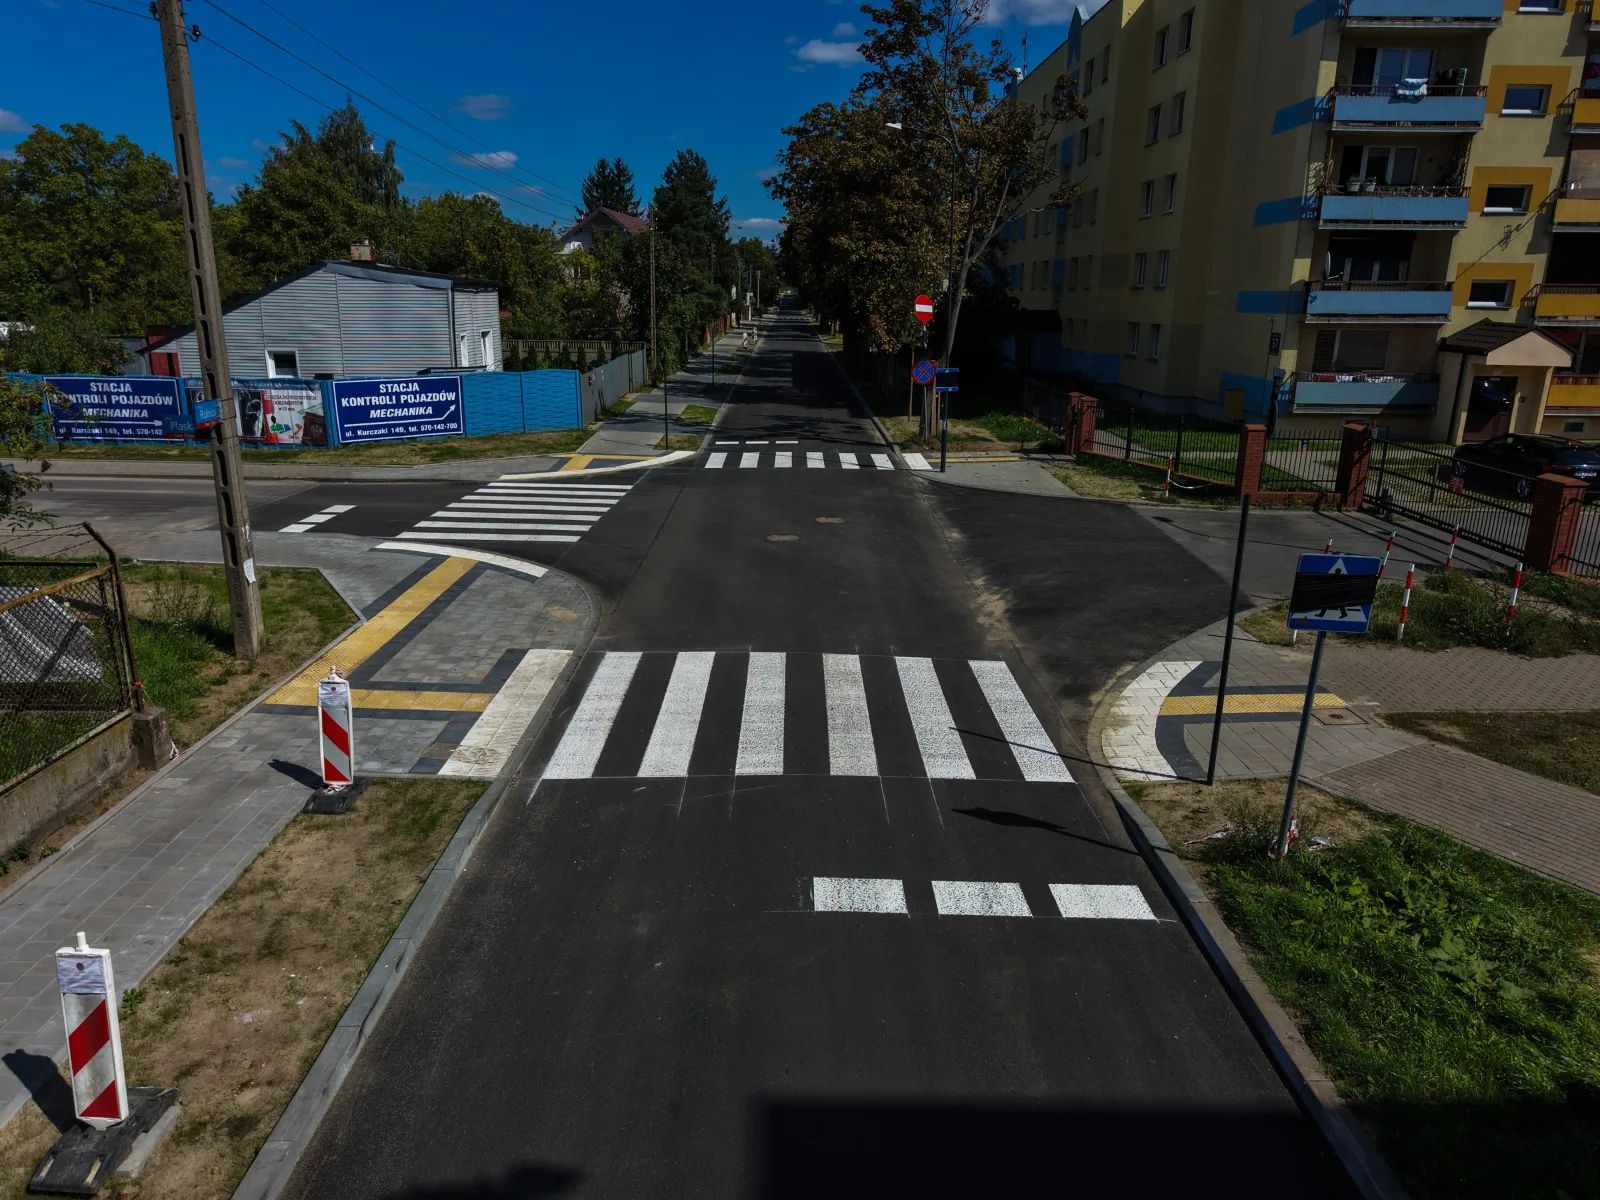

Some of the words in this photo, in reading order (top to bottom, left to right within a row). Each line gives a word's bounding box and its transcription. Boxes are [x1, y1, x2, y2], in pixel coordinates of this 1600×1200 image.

[90, 382, 133, 392] STACJA
[379, 382, 420, 393] STACJA
[52, 393, 107, 404] NTROLI
[111, 393, 173, 405] POJAZDÓW
[341, 395, 396, 407] KONTROLI
[400, 390, 456, 404] POJAZDÓW
[83, 407, 149, 418] MECHANIKA
[369, 406, 433, 418] MECHANIKA
[136, 428, 163, 436] 570-142
[357, 428, 388, 436] Kurczaki
[391, 426, 407, 434] 149,
[408, 425, 419, 433] tel.
[420, 423, 458, 432] 570-142-700
